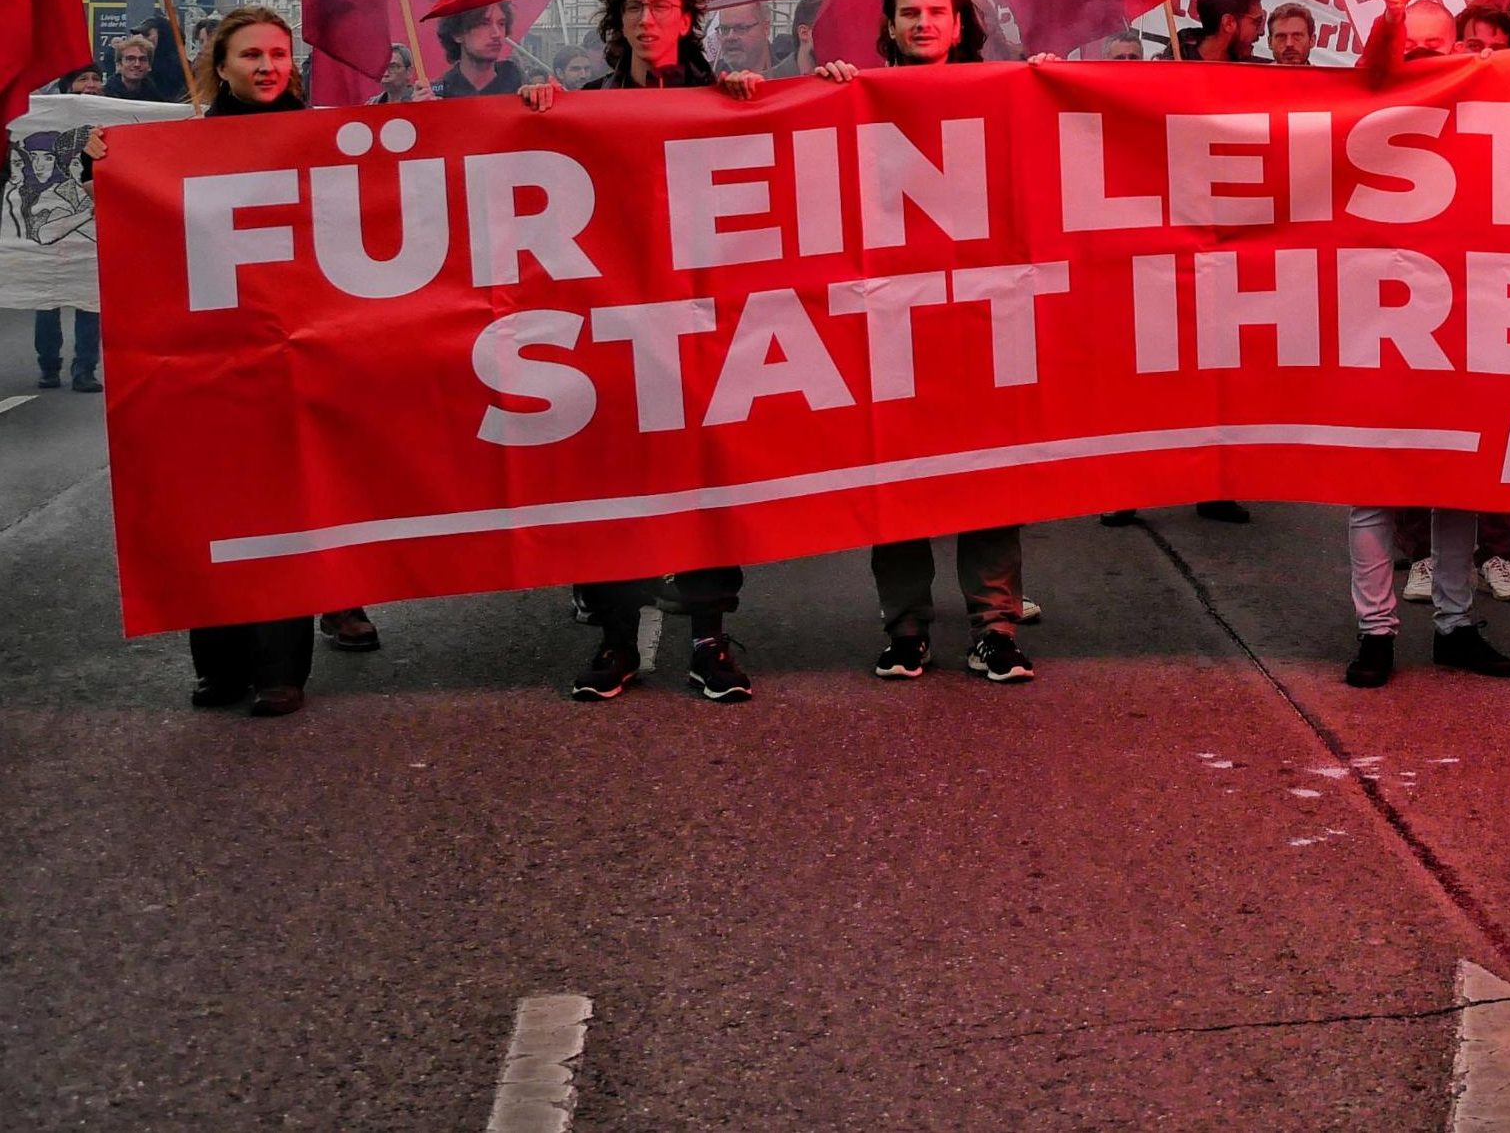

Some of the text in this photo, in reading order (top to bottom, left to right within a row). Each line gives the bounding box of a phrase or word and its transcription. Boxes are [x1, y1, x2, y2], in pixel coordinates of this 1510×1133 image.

[183, 118, 602, 312] FÜR
[664, 117, 990, 272] EIN
[470, 260, 1072, 447] STATT
